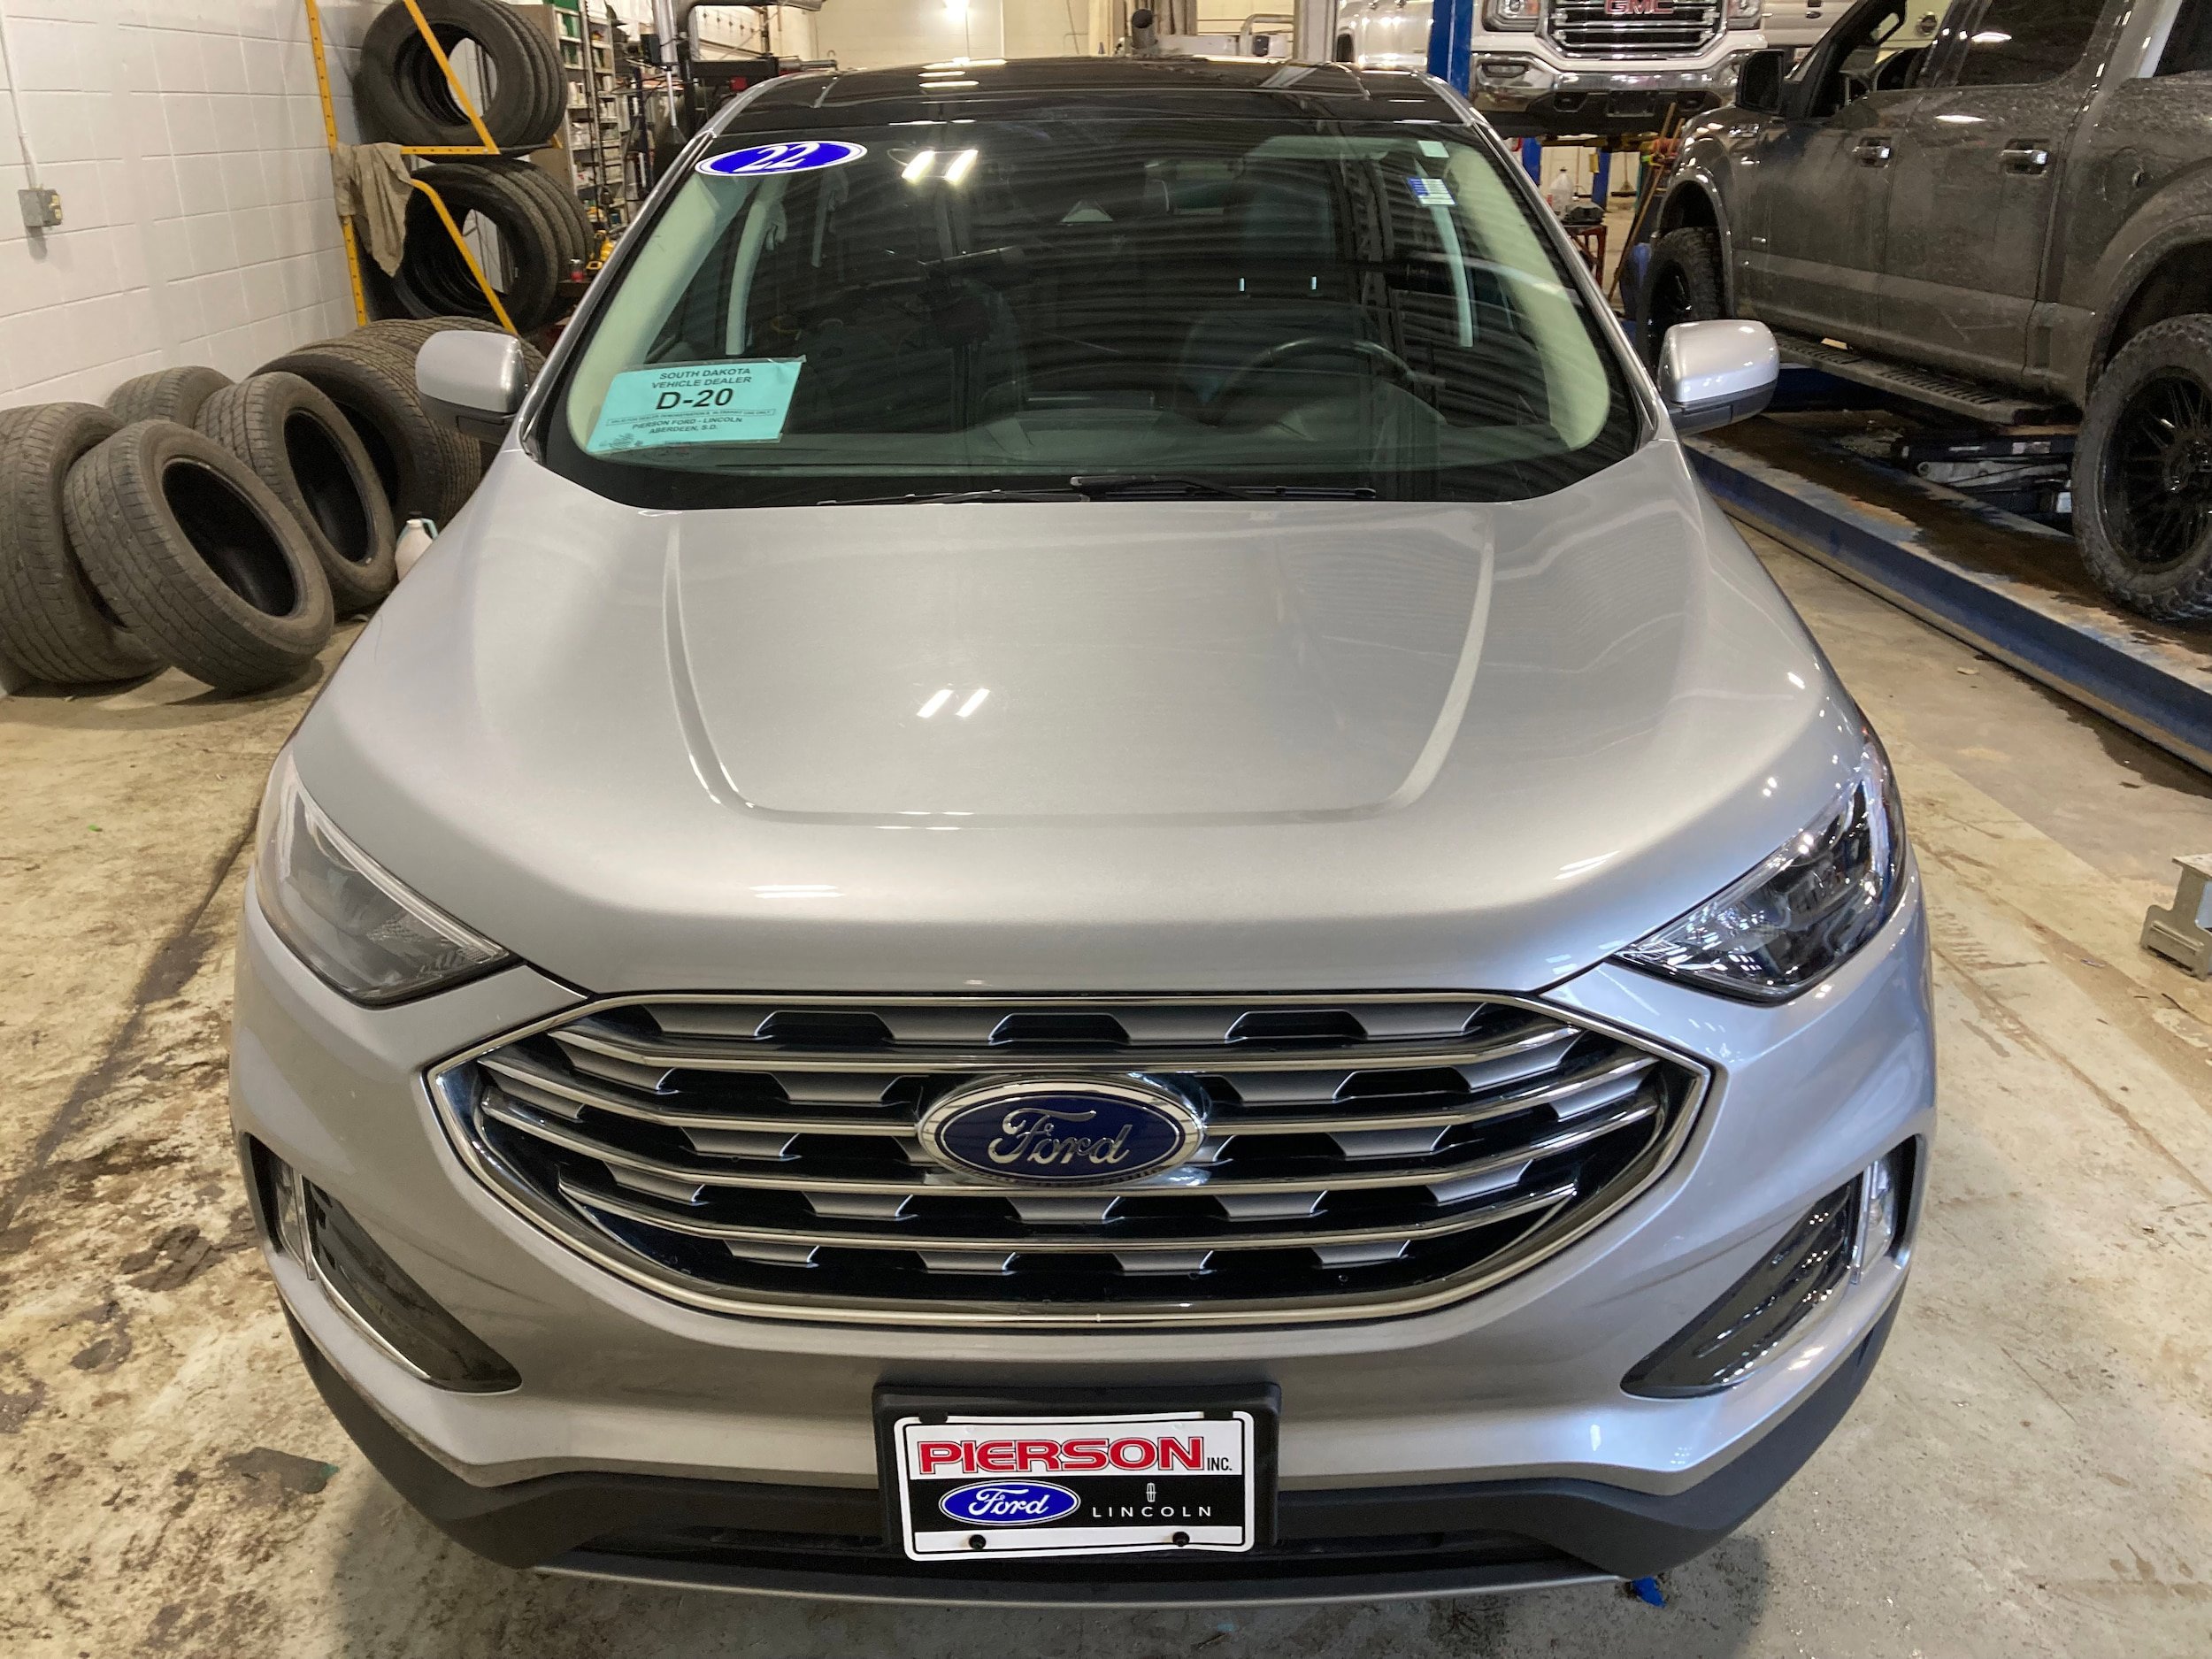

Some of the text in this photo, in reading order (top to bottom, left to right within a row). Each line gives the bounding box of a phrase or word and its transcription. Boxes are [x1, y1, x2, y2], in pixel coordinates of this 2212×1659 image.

[1604, 0, 1674, 14] GMC
[732, 142, 821, 173] 22
[659, 368, 751, 380] SOUTH DAKOTA
[651, 376, 752, 388] VEHICLE DEALER
[656, 388, 734, 410] D-20
[632, 419, 670, 430] PIERSON
[649, 425, 699, 434] ABERDEEN,
[987, 1107, 1133, 1164] Ford
[917, 1436, 1233, 1476] PIERSON INC.
[967, 1487, 1051, 1517] Ford
[1092, 1506, 1212, 1518] LINCOLN
